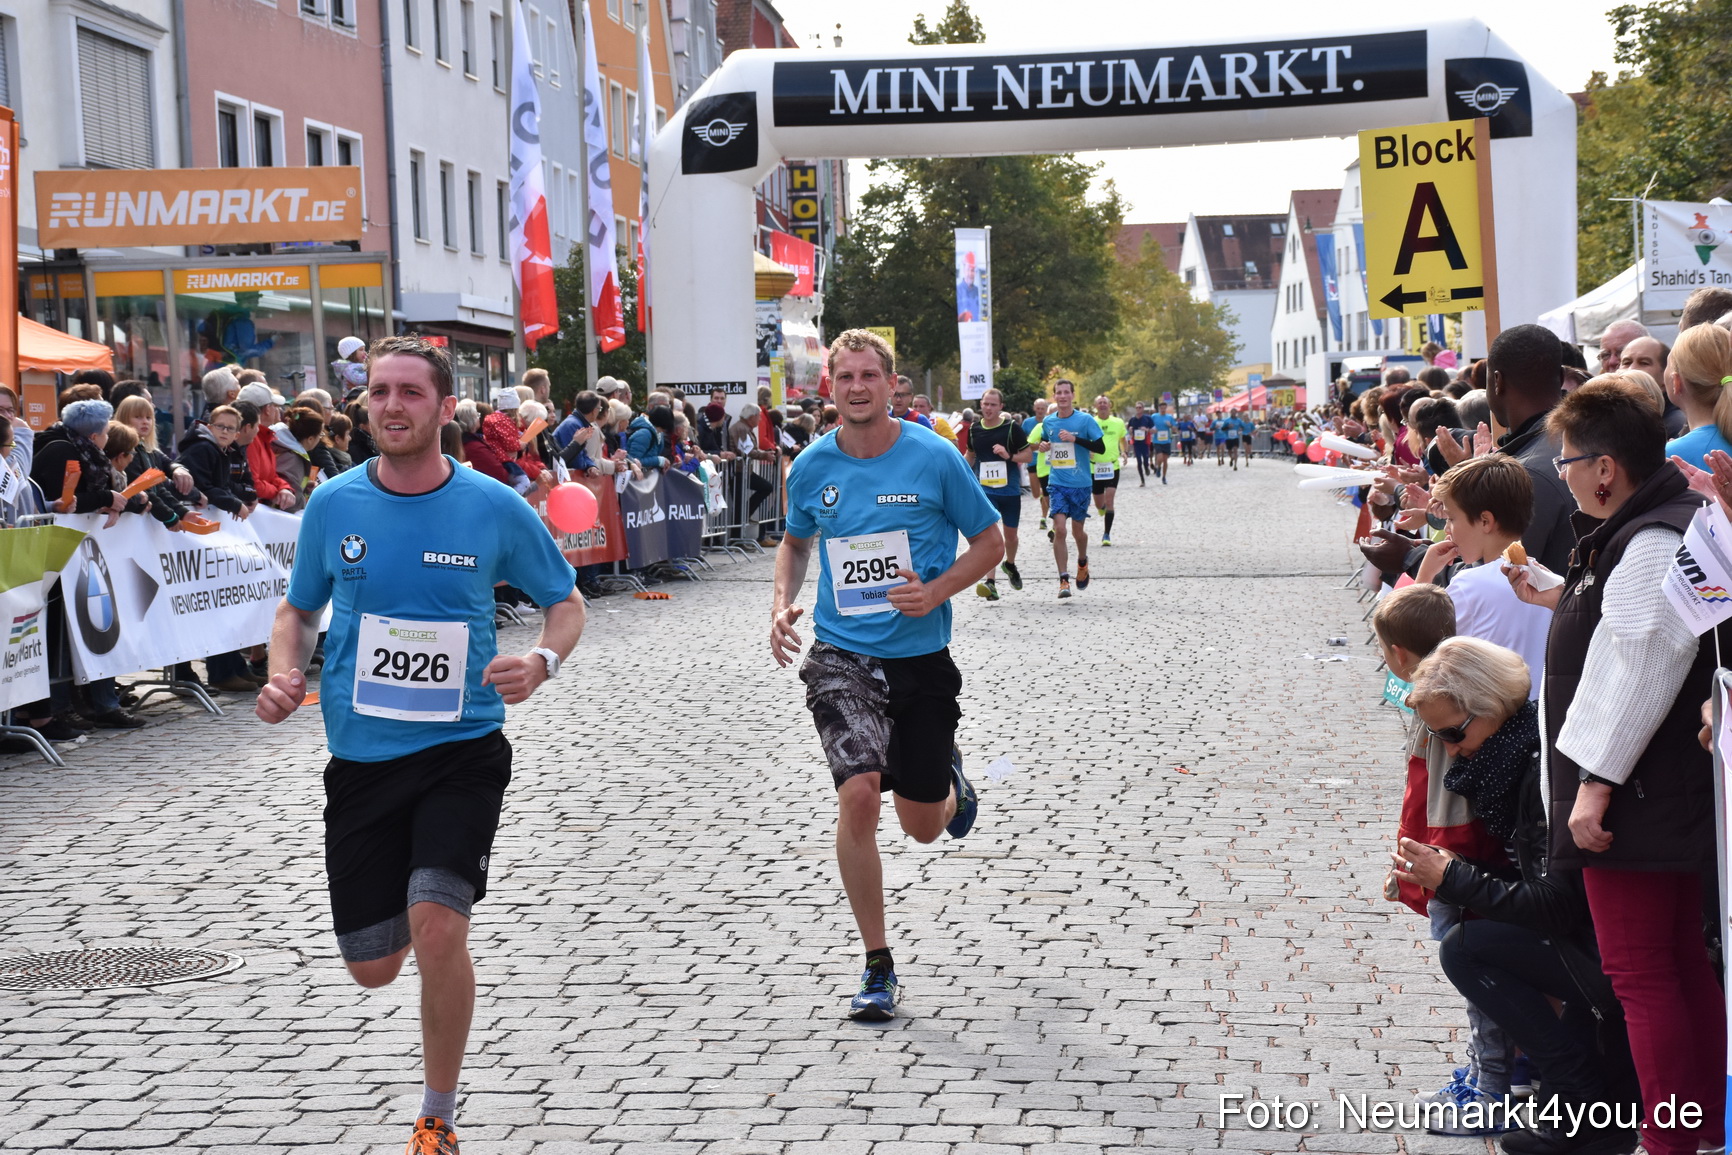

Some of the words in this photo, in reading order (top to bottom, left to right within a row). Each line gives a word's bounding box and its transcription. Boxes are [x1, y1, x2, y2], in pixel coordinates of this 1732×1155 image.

[829, 65, 975, 116] MINI
[992, 45, 1366, 111] NEUMARKT.
[1477, 92, 1498, 102] MINI
[709, 128, 729, 137] MINI
[1375, 129, 1476, 169] Block
[49, 188, 347, 229] RUNMARKT.DE
[1393, 181, 1469, 276] A
[1652, 269, 1706, 286] Shahid's
[1054, 450, 1069, 459] 208
[986, 469, 999, 478] 111
[877, 494, 919, 504] BOCK
[857, 541, 884, 550] BOCK
[423, 551, 477, 567] BOCK
[159, 548, 202, 586] BMW
[342, 567, 367, 577] PARTL
[843, 555, 900, 585] 2595
[861, 590, 888, 600] Tobias
[400, 630, 438, 641] BOCK
[371, 647, 450, 683] 2926
